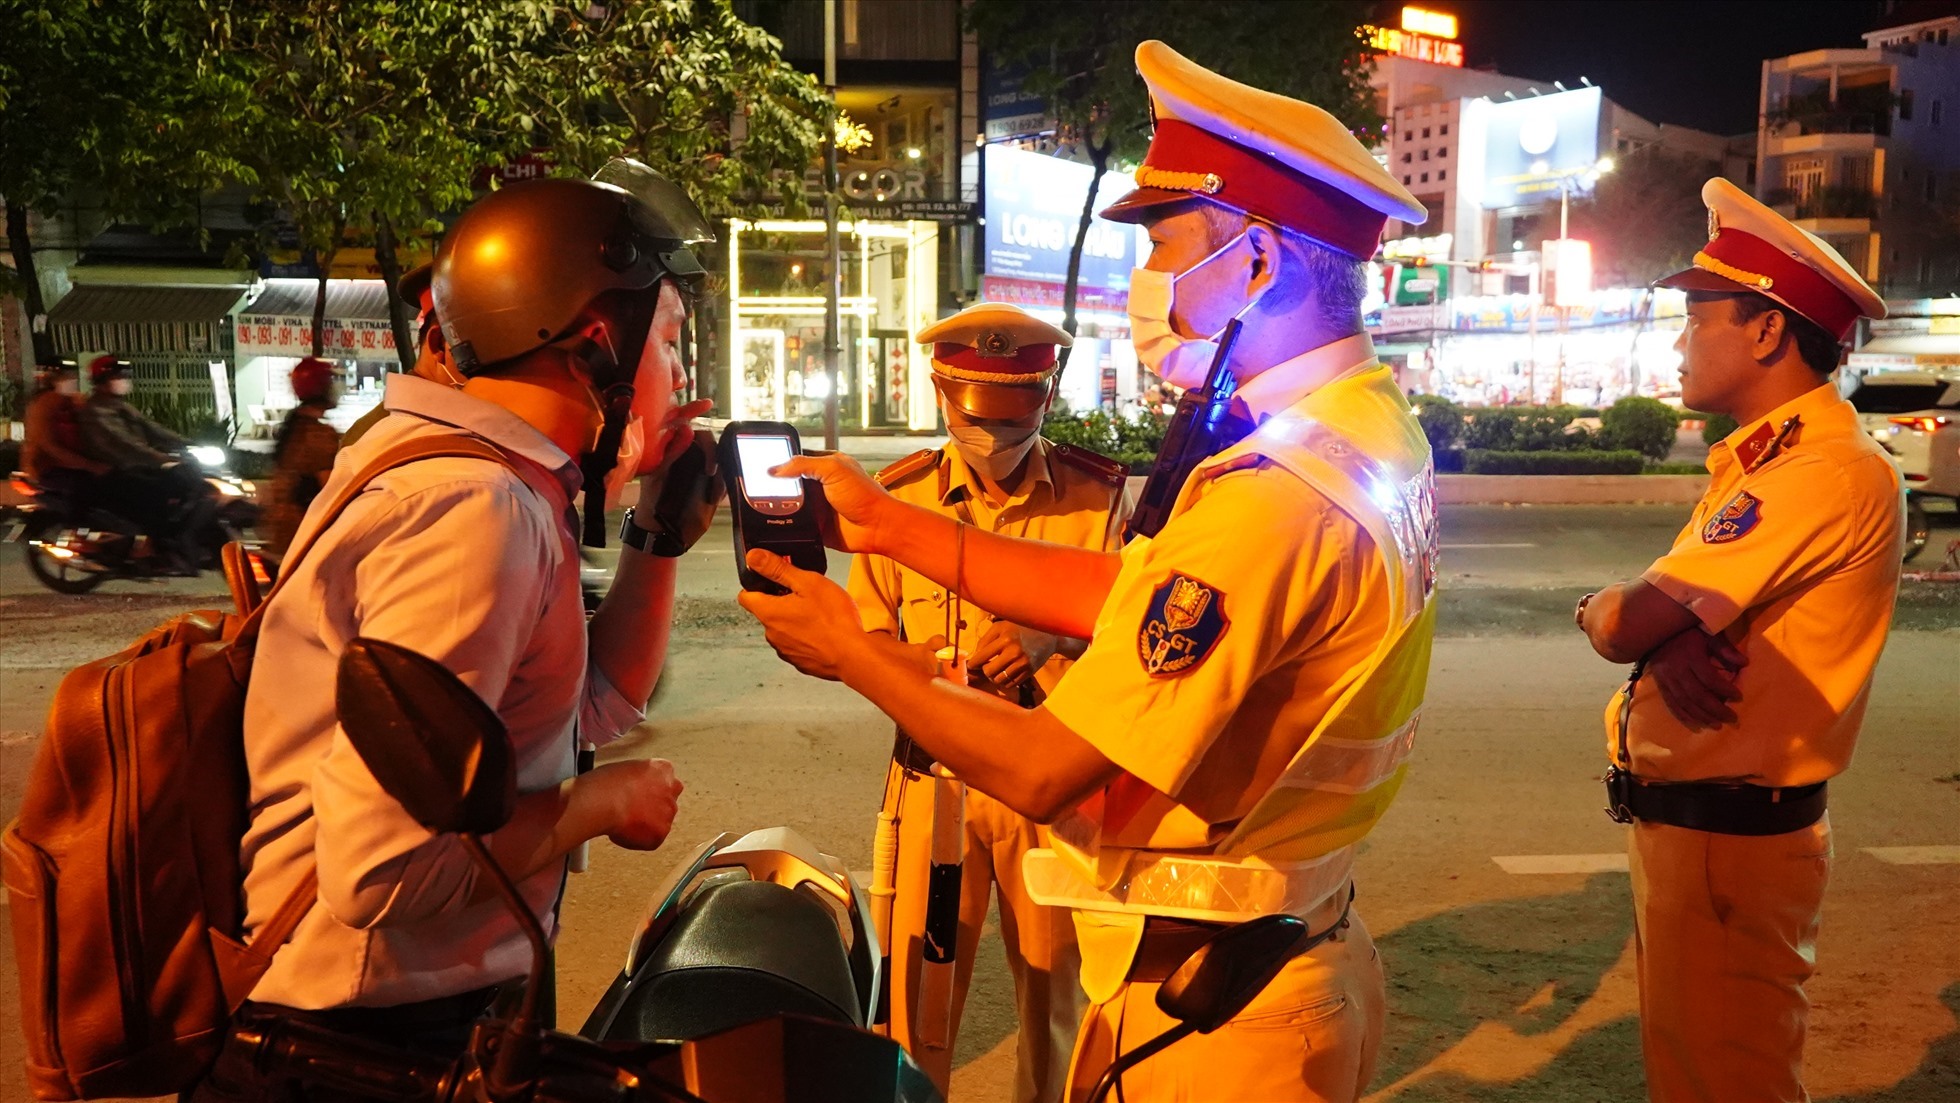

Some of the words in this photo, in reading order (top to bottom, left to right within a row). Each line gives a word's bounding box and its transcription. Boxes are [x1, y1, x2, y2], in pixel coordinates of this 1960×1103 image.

[1001, 211, 1065, 251] LONG
[1722, 521, 1740, 533] GT
[1147, 619, 1167, 640] CS
[1170, 633, 1198, 655] GT
